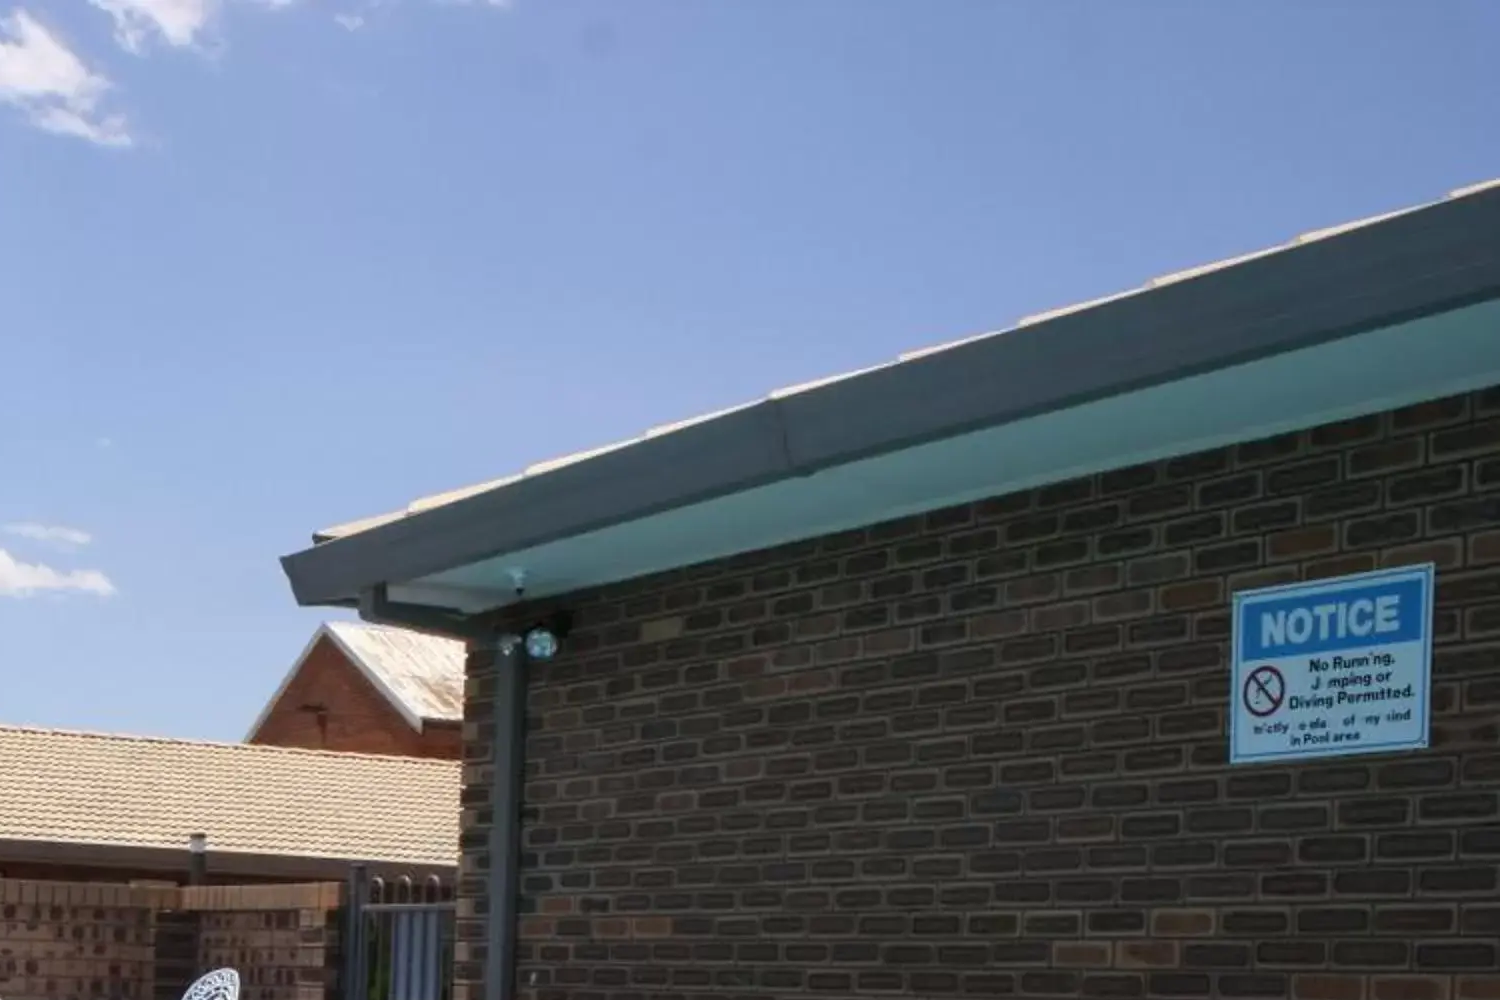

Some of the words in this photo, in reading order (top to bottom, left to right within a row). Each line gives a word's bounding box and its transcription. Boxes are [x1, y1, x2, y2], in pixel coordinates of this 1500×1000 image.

[1261, 594, 1400, 648] NOTICE
[1309, 658, 1329, 673] No
[1311, 672, 1372, 691] Jmping
[1376, 671, 1393, 682] or
[1289, 692, 1333, 710] Diving
[1303, 731, 1330, 746] Pool
